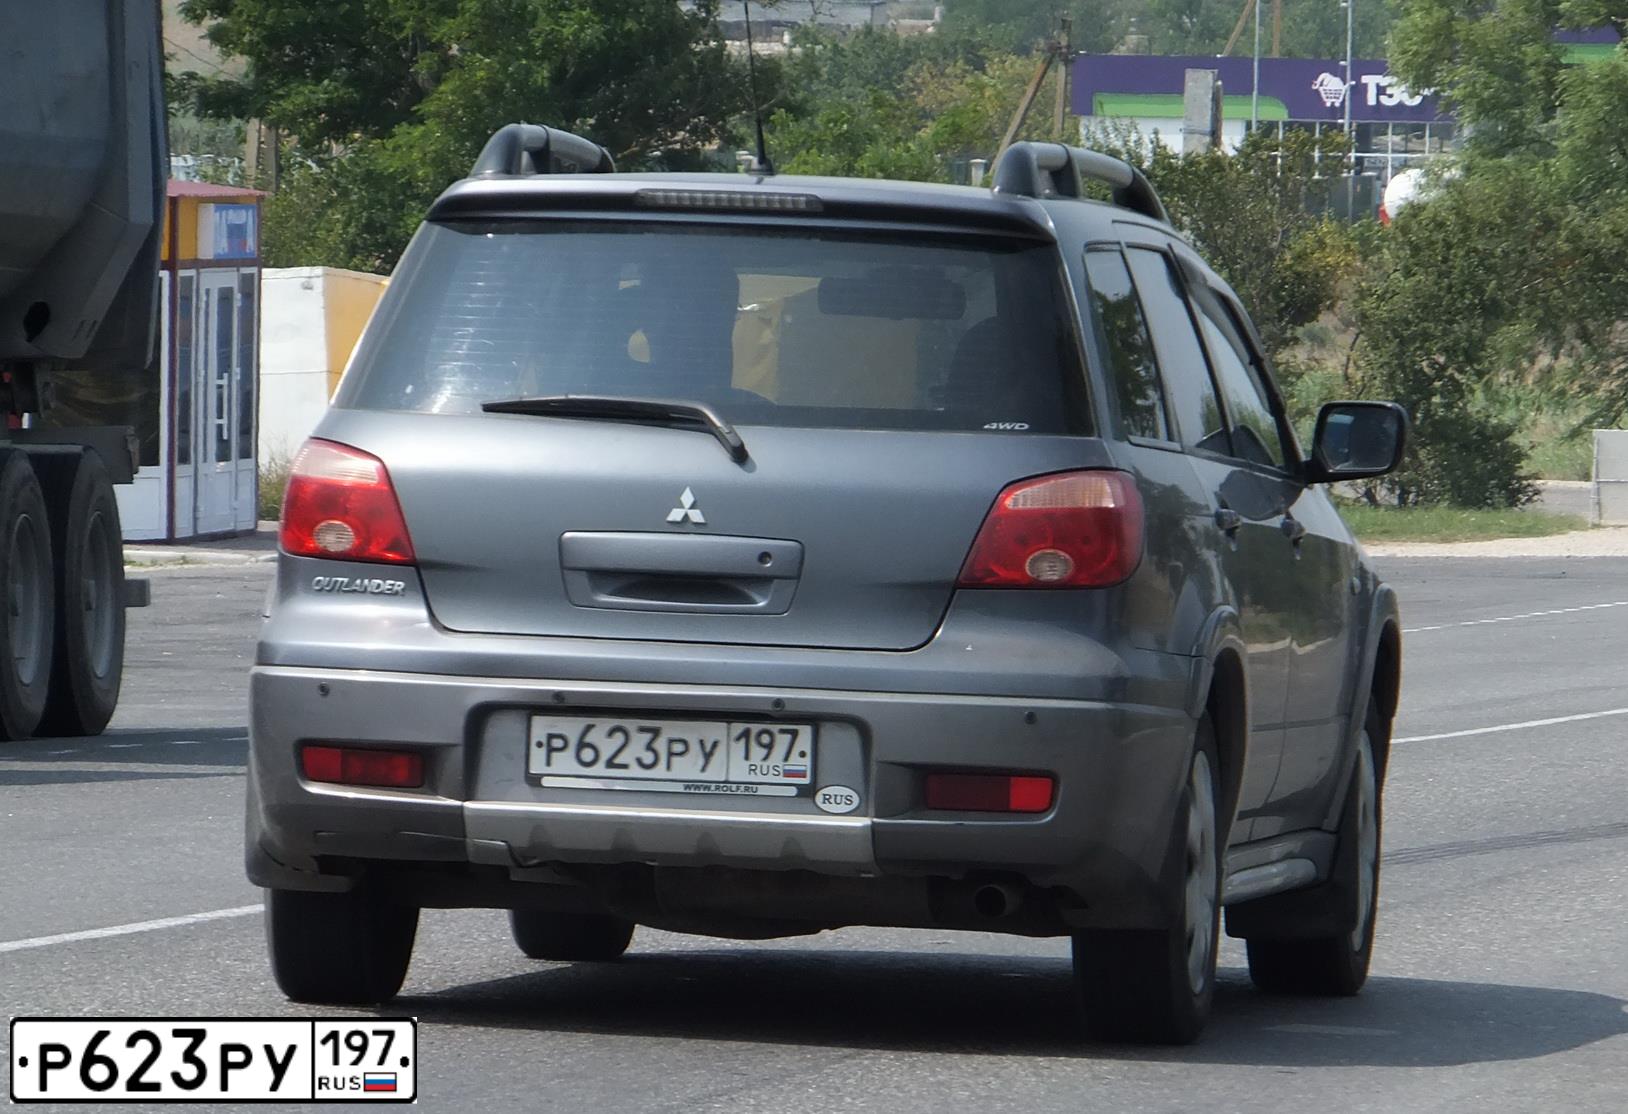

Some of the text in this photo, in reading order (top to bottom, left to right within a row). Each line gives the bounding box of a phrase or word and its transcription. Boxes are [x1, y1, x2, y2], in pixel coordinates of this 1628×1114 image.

[983, 422, 1030, 430] 4WD
[312, 576, 405, 595] OUTLANDER
[733, 726, 799, 763] 197
[748, 763, 781, 777] RUS
[683, 783, 759, 794] WWW.ROLF.RU
[821, 793, 854, 806] RUS
